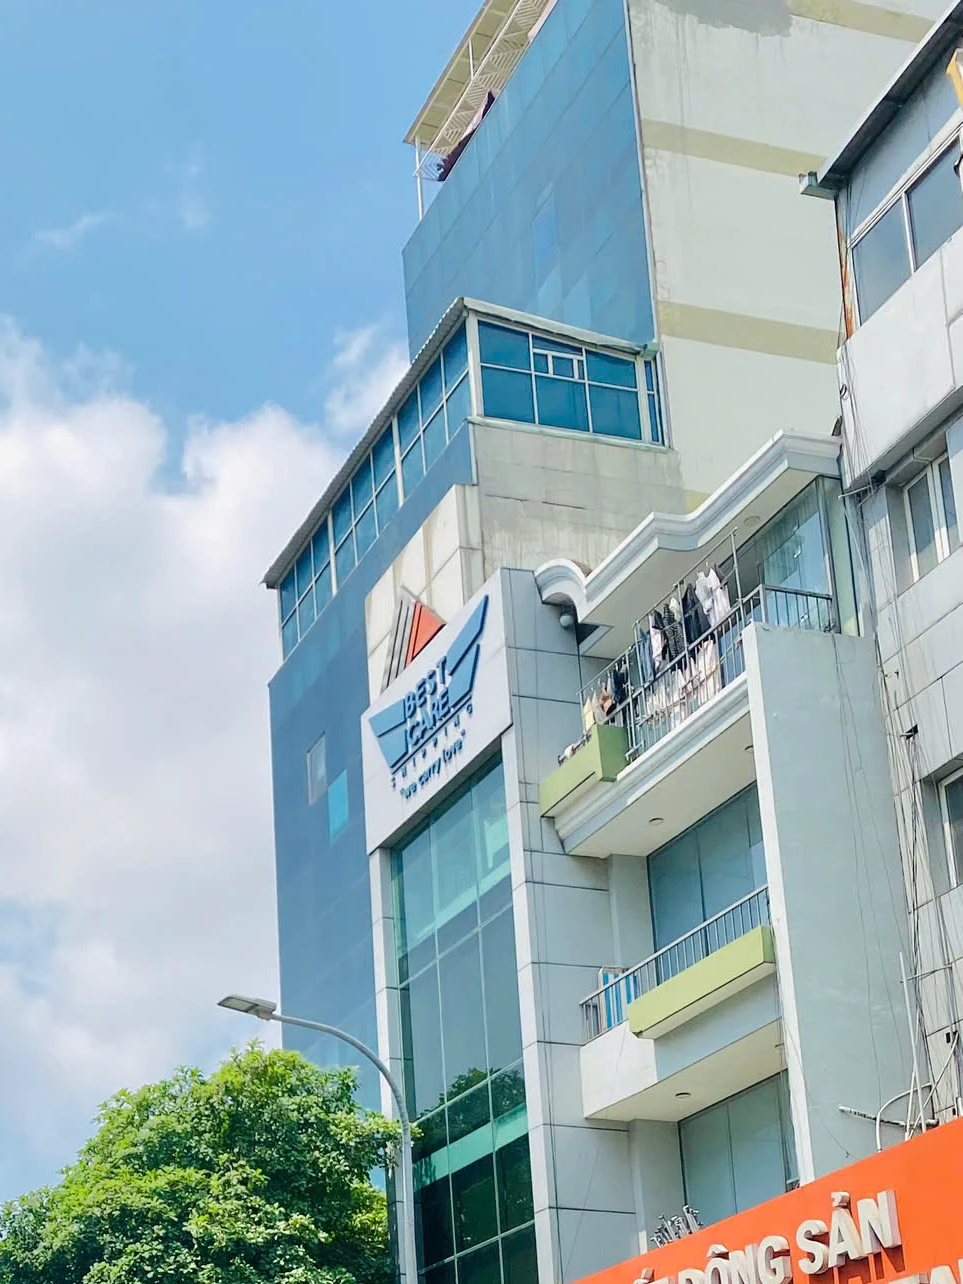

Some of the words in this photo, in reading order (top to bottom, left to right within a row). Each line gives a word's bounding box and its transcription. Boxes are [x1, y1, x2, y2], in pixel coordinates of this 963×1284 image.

[406, 656, 447, 718] BEST
[409, 687, 451, 746] CARE
[796, 1190, 903, 1275] SẢN
